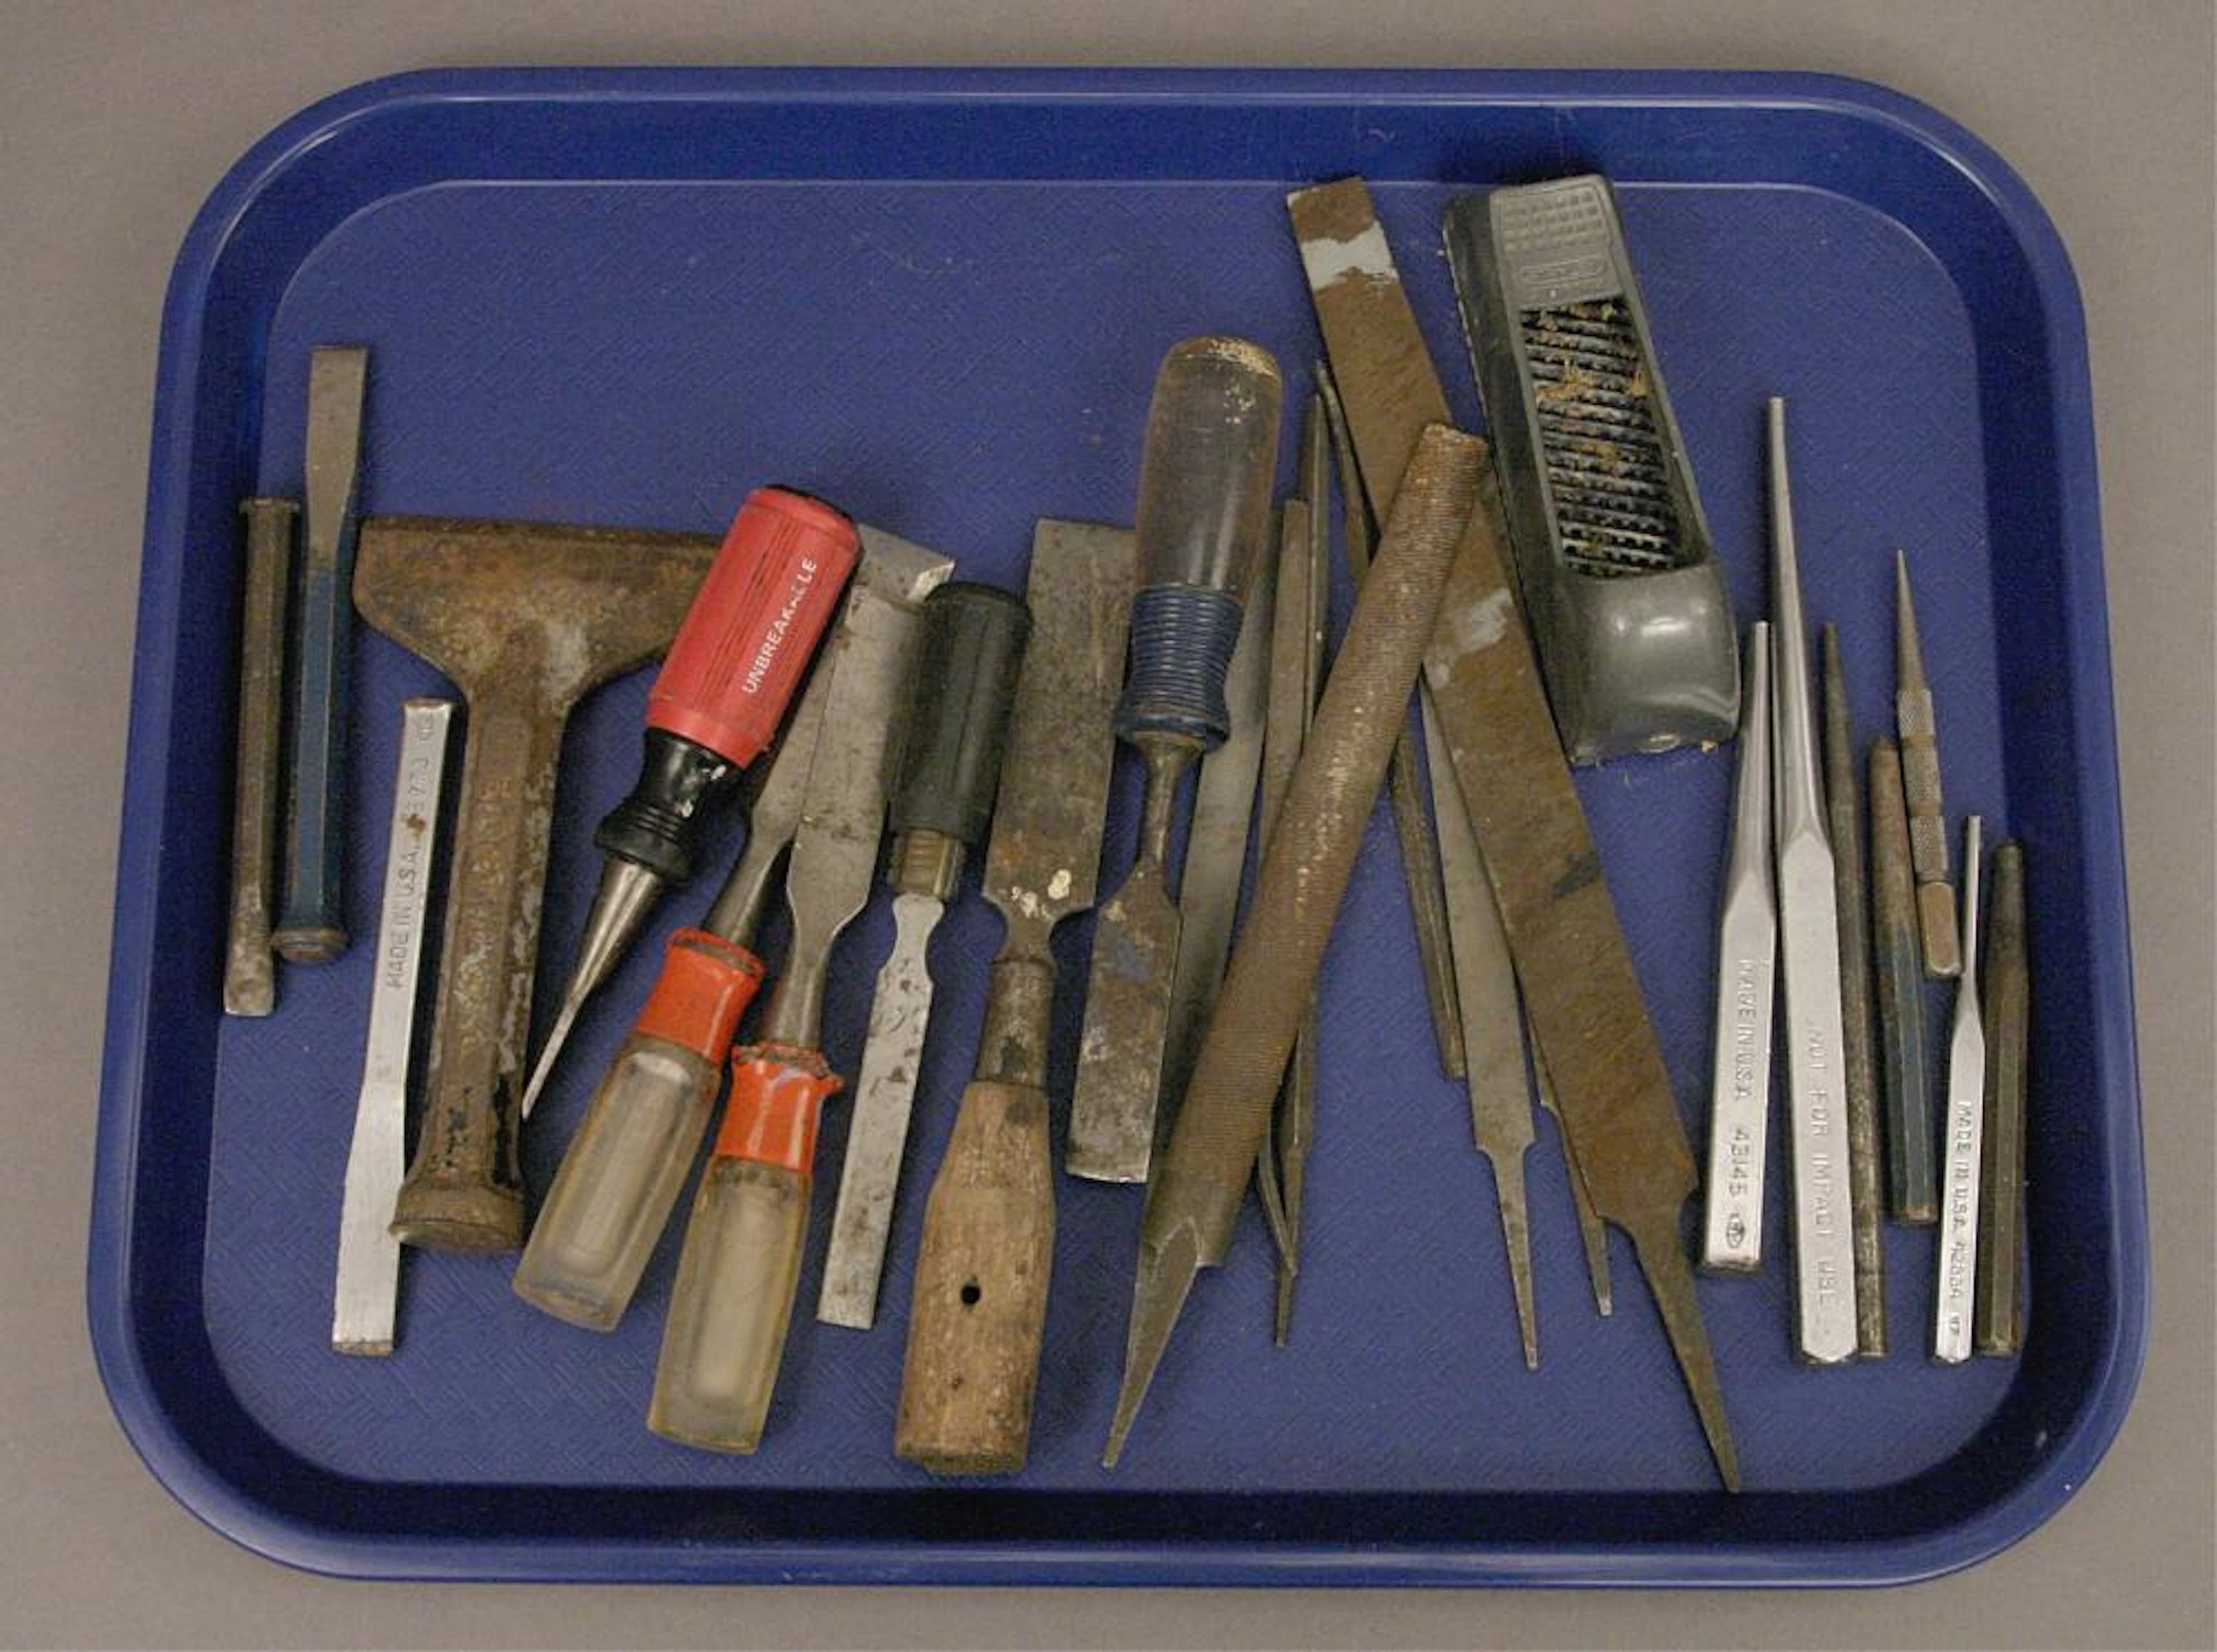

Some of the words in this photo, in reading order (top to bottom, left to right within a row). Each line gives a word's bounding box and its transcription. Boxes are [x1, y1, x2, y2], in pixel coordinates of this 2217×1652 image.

[392, 905, 412, 926] IN
[386, 932, 409, 990] MADE
[1736, 958, 1756, 1019] MADE
[1736, 1023, 1756, 1046] IN
[1955, 1100, 1972, 1153] MADE
[1811, 1153, 1834, 1236] IMPACT
[1954, 1159, 1970, 1179] IN
